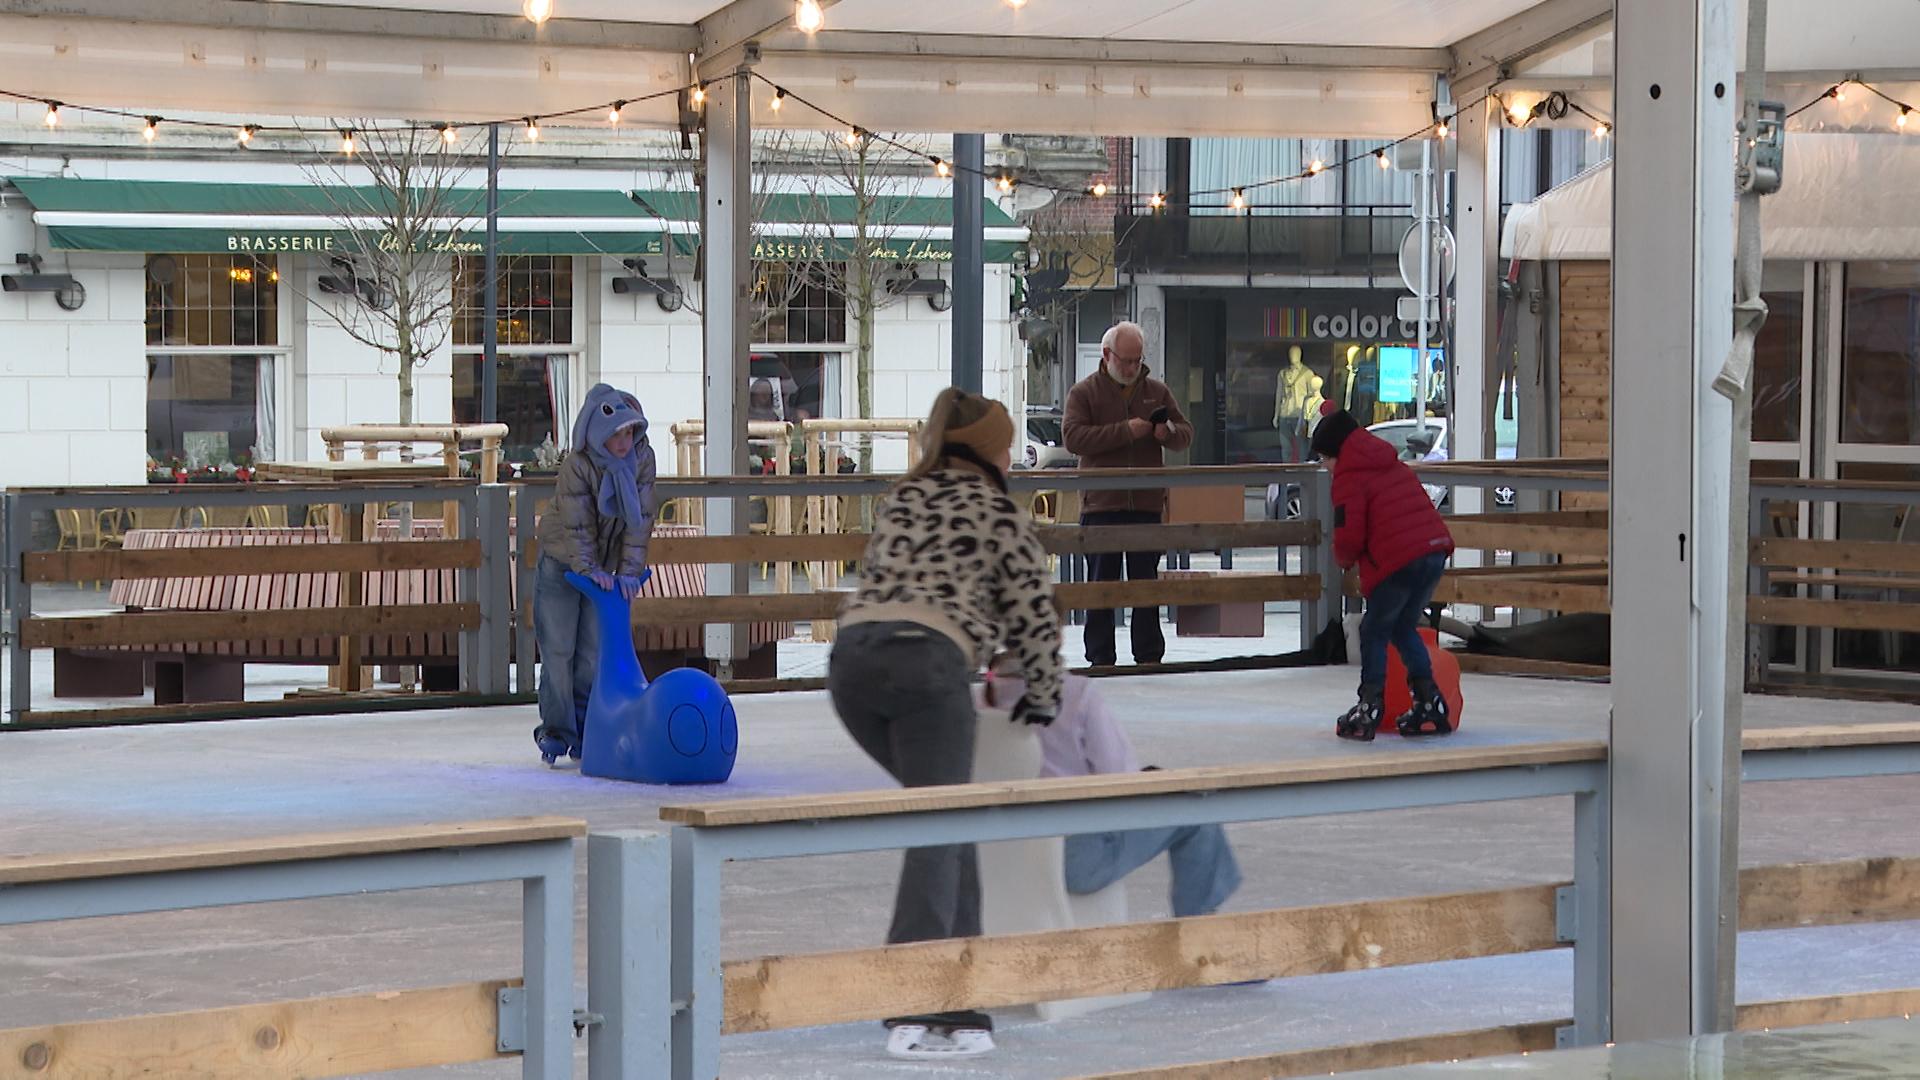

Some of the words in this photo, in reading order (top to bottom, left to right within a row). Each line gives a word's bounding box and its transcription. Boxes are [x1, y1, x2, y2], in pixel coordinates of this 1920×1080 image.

[227, 236, 334, 250] BRASSERIE
[379, 232, 418, 252] Chz
[754, 242, 825, 258] ASSERIE
[1312, 307, 1393, 339] color
[1399, 316, 1438, 339] co
